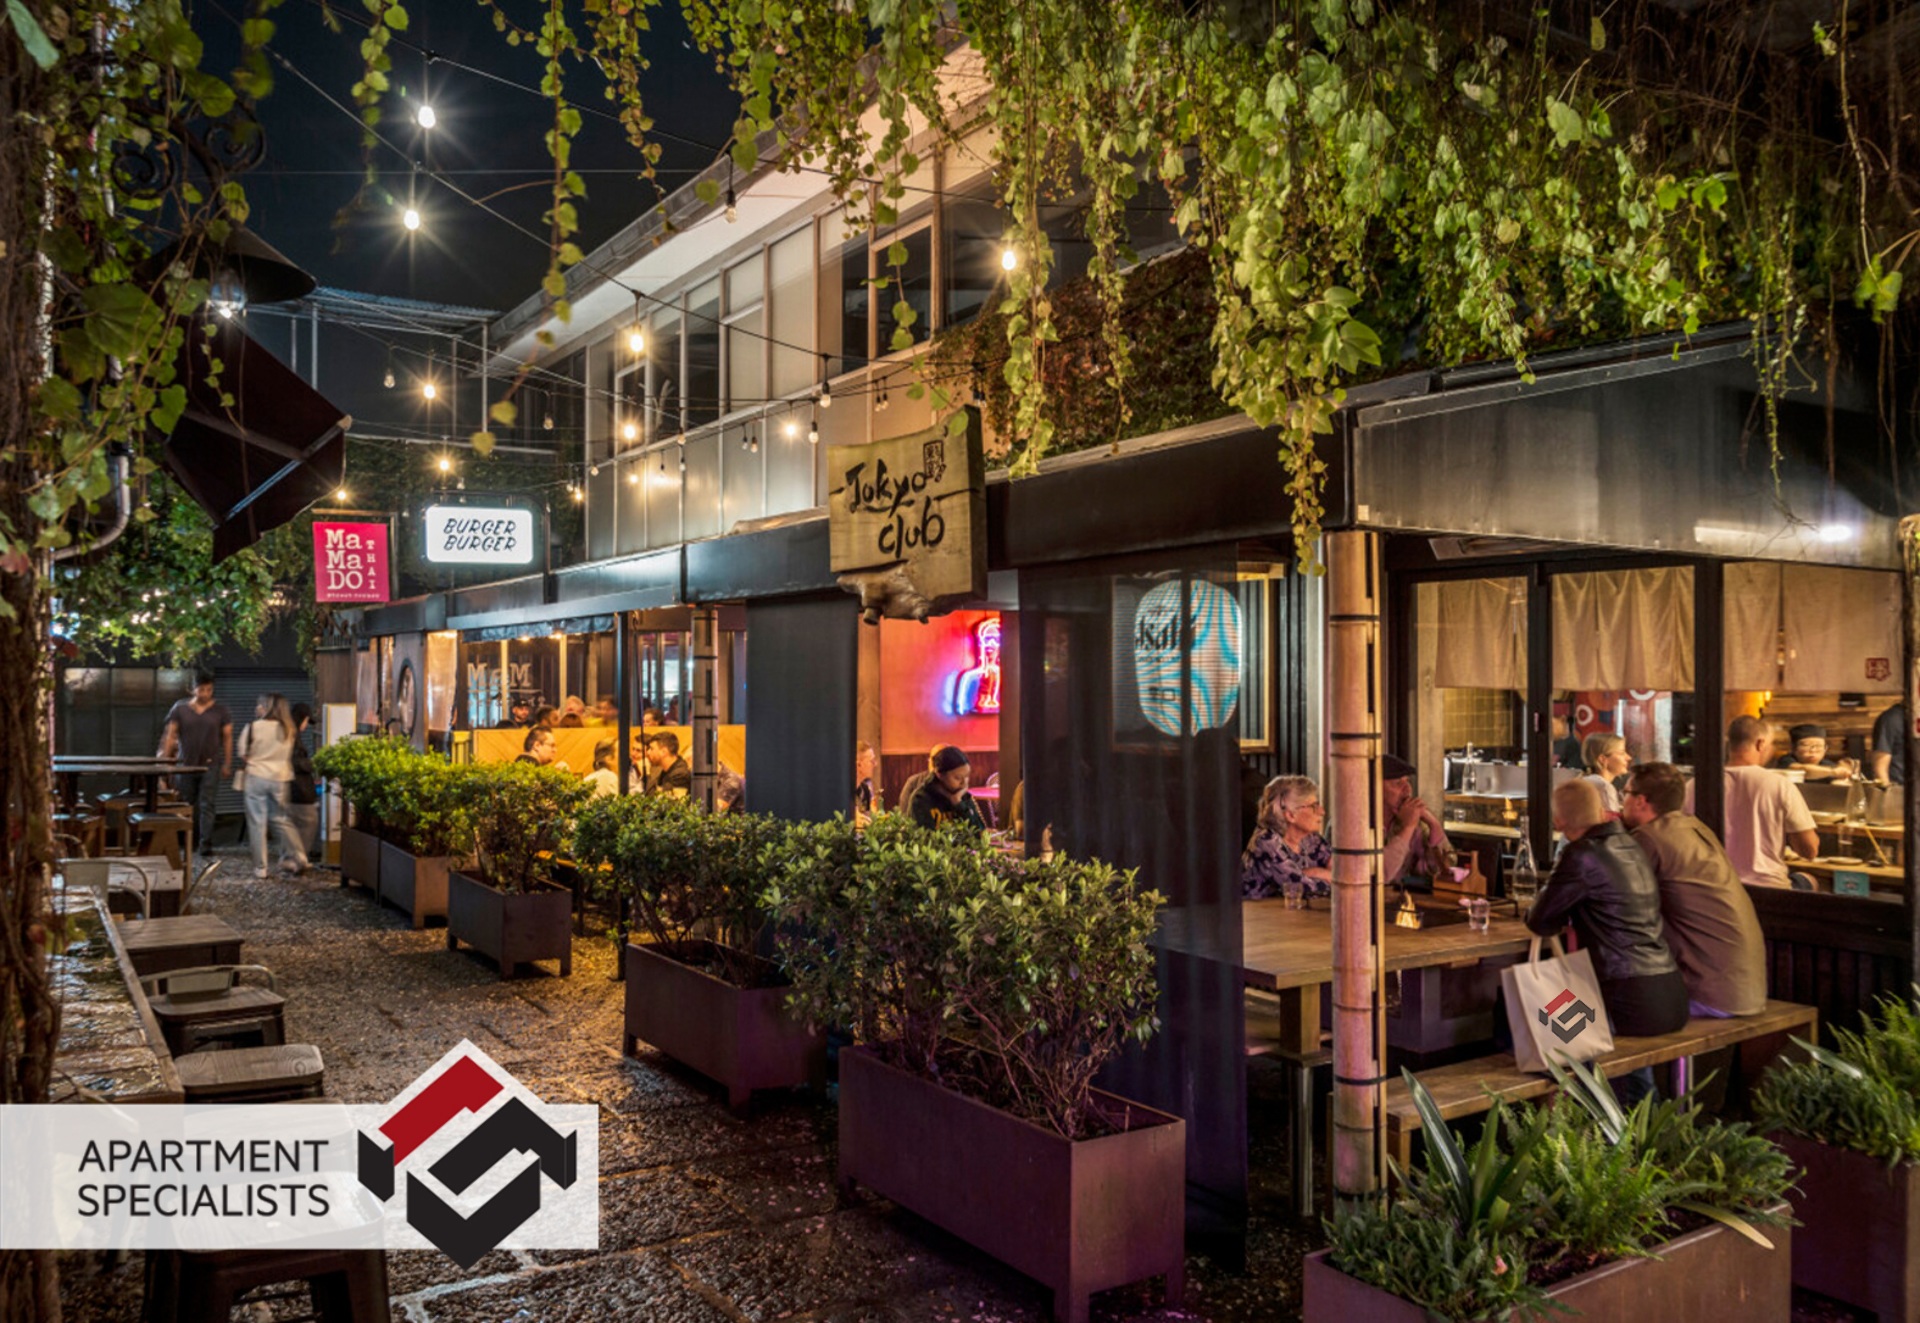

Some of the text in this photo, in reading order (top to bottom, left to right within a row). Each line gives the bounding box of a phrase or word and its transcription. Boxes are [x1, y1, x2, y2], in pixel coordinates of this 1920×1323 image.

[844, 458, 928, 518] Tokyo
[443, 517, 517, 535] BURGER
[324, 528, 363, 550] Ma
[443, 534, 517, 552] BURGER
[325, 549, 364, 570] Ma
[365, 539, 376, 590] THAI
[326, 570, 364, 590] DO
